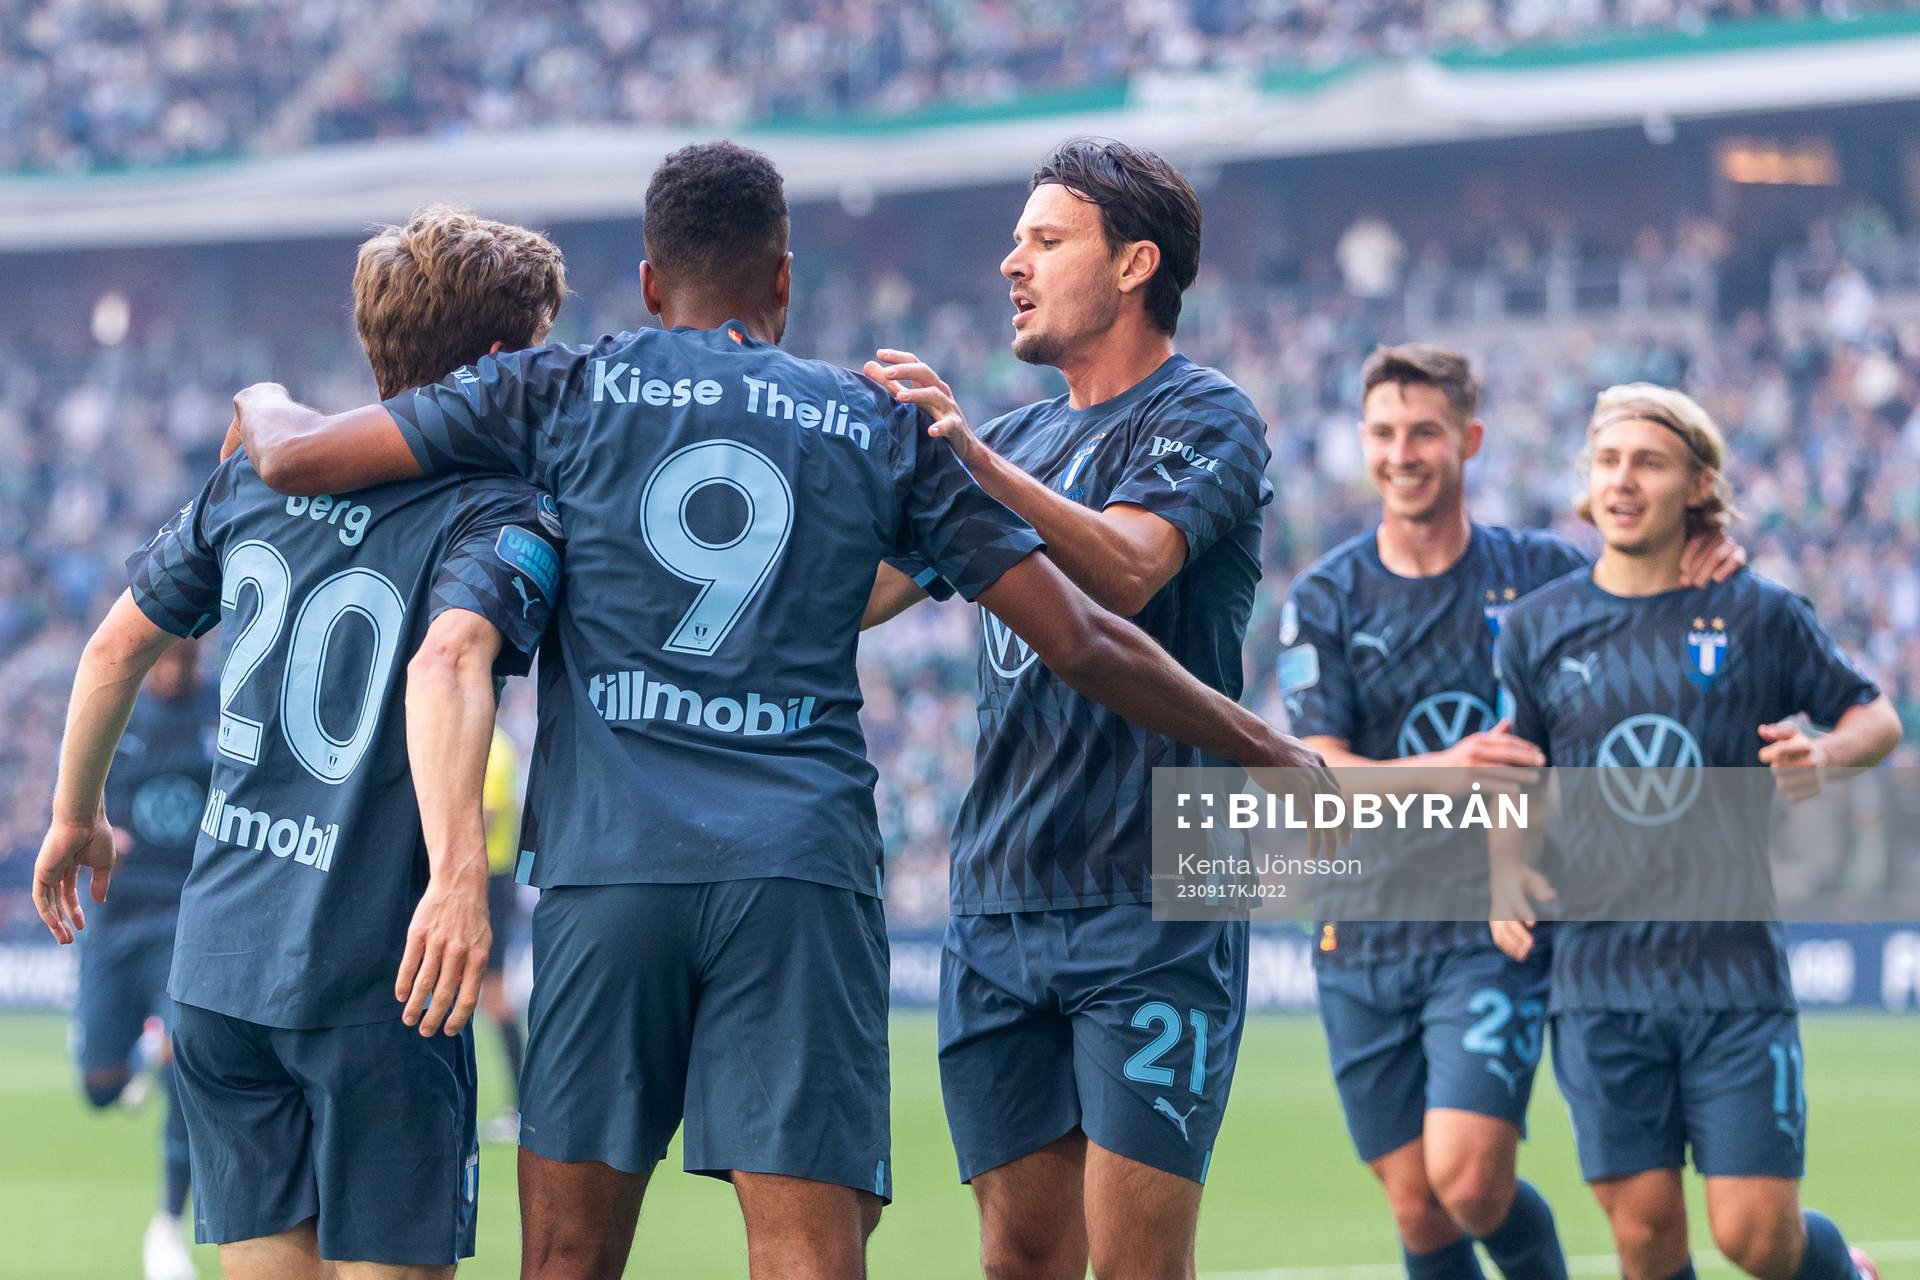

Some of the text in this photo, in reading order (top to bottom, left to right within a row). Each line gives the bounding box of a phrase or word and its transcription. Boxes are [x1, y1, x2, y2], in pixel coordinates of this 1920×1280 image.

[592, 360, 870, 450] Kiese Thelin
[1148, 435, 1219, 473] Boozt
[640, 438, 795, 656] 9
[217, 539, 406, 785] 20
[1597, 713, 1703, 827] VW
[1123, 1001, 1209, 1095] 21
